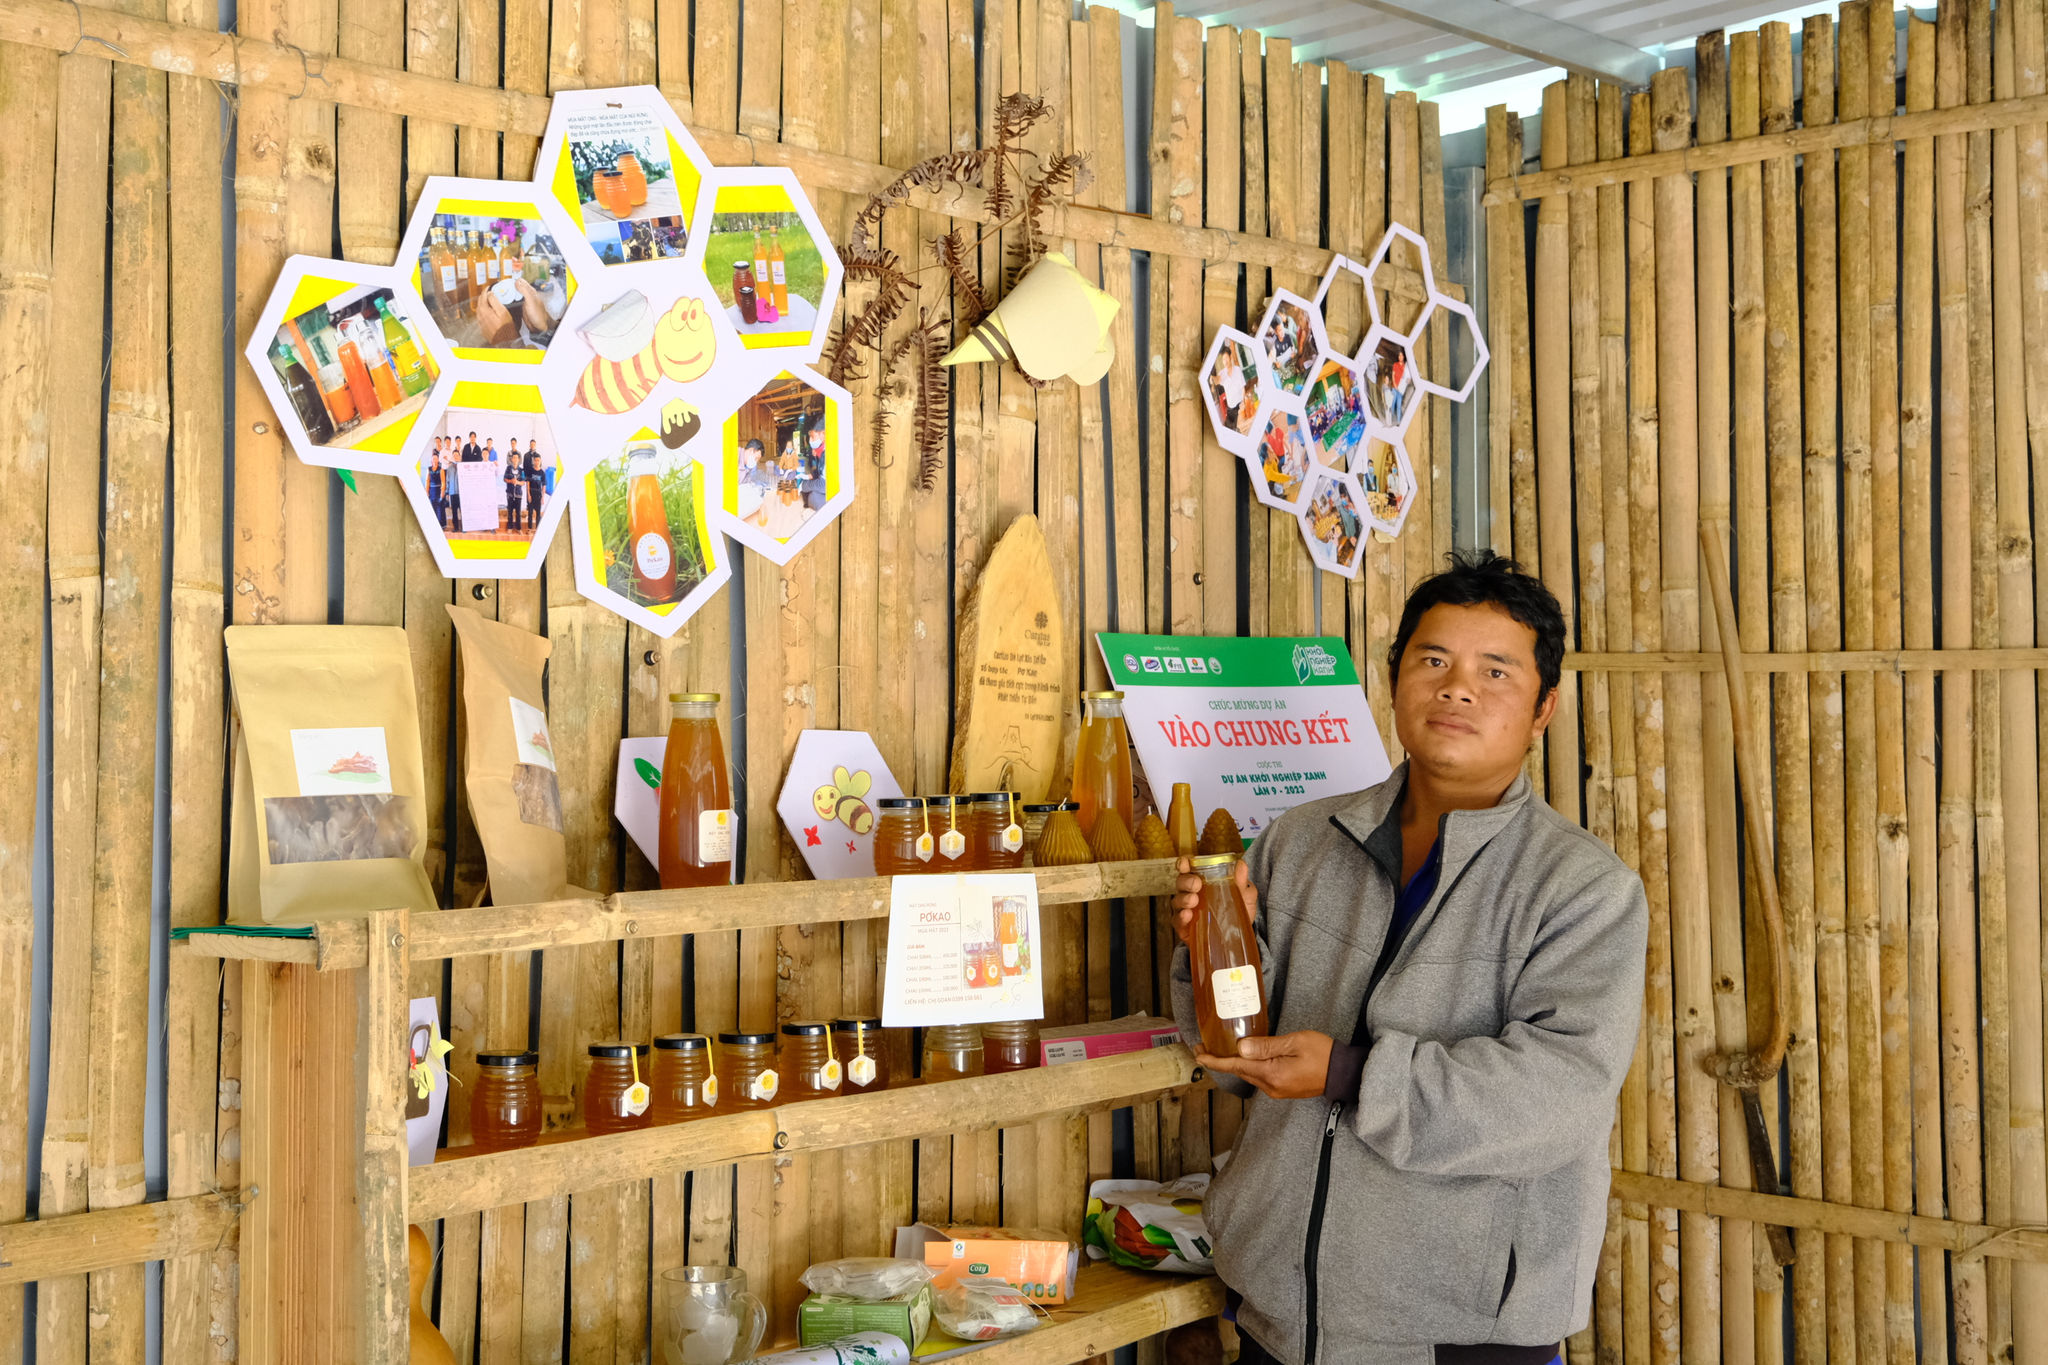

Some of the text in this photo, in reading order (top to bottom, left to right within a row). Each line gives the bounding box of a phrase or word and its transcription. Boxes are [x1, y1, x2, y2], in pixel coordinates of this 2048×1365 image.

[1208, 698, 1287, 712] CHÚC MỪNG DỰ ÁN
[1158, 710, 1351, 748] VÀO CHUNG KẾT
[1221, 774, 1234, 786] DỰ
[1271, 771, 1302, 784] NGHIỆP
[1303, 770, 1327, 781] XANH
[1271, 786, 1277, 795] 9
[1284, 785, 1305, 795] 2023
[969, 1265, 987, 1273] Cozy
